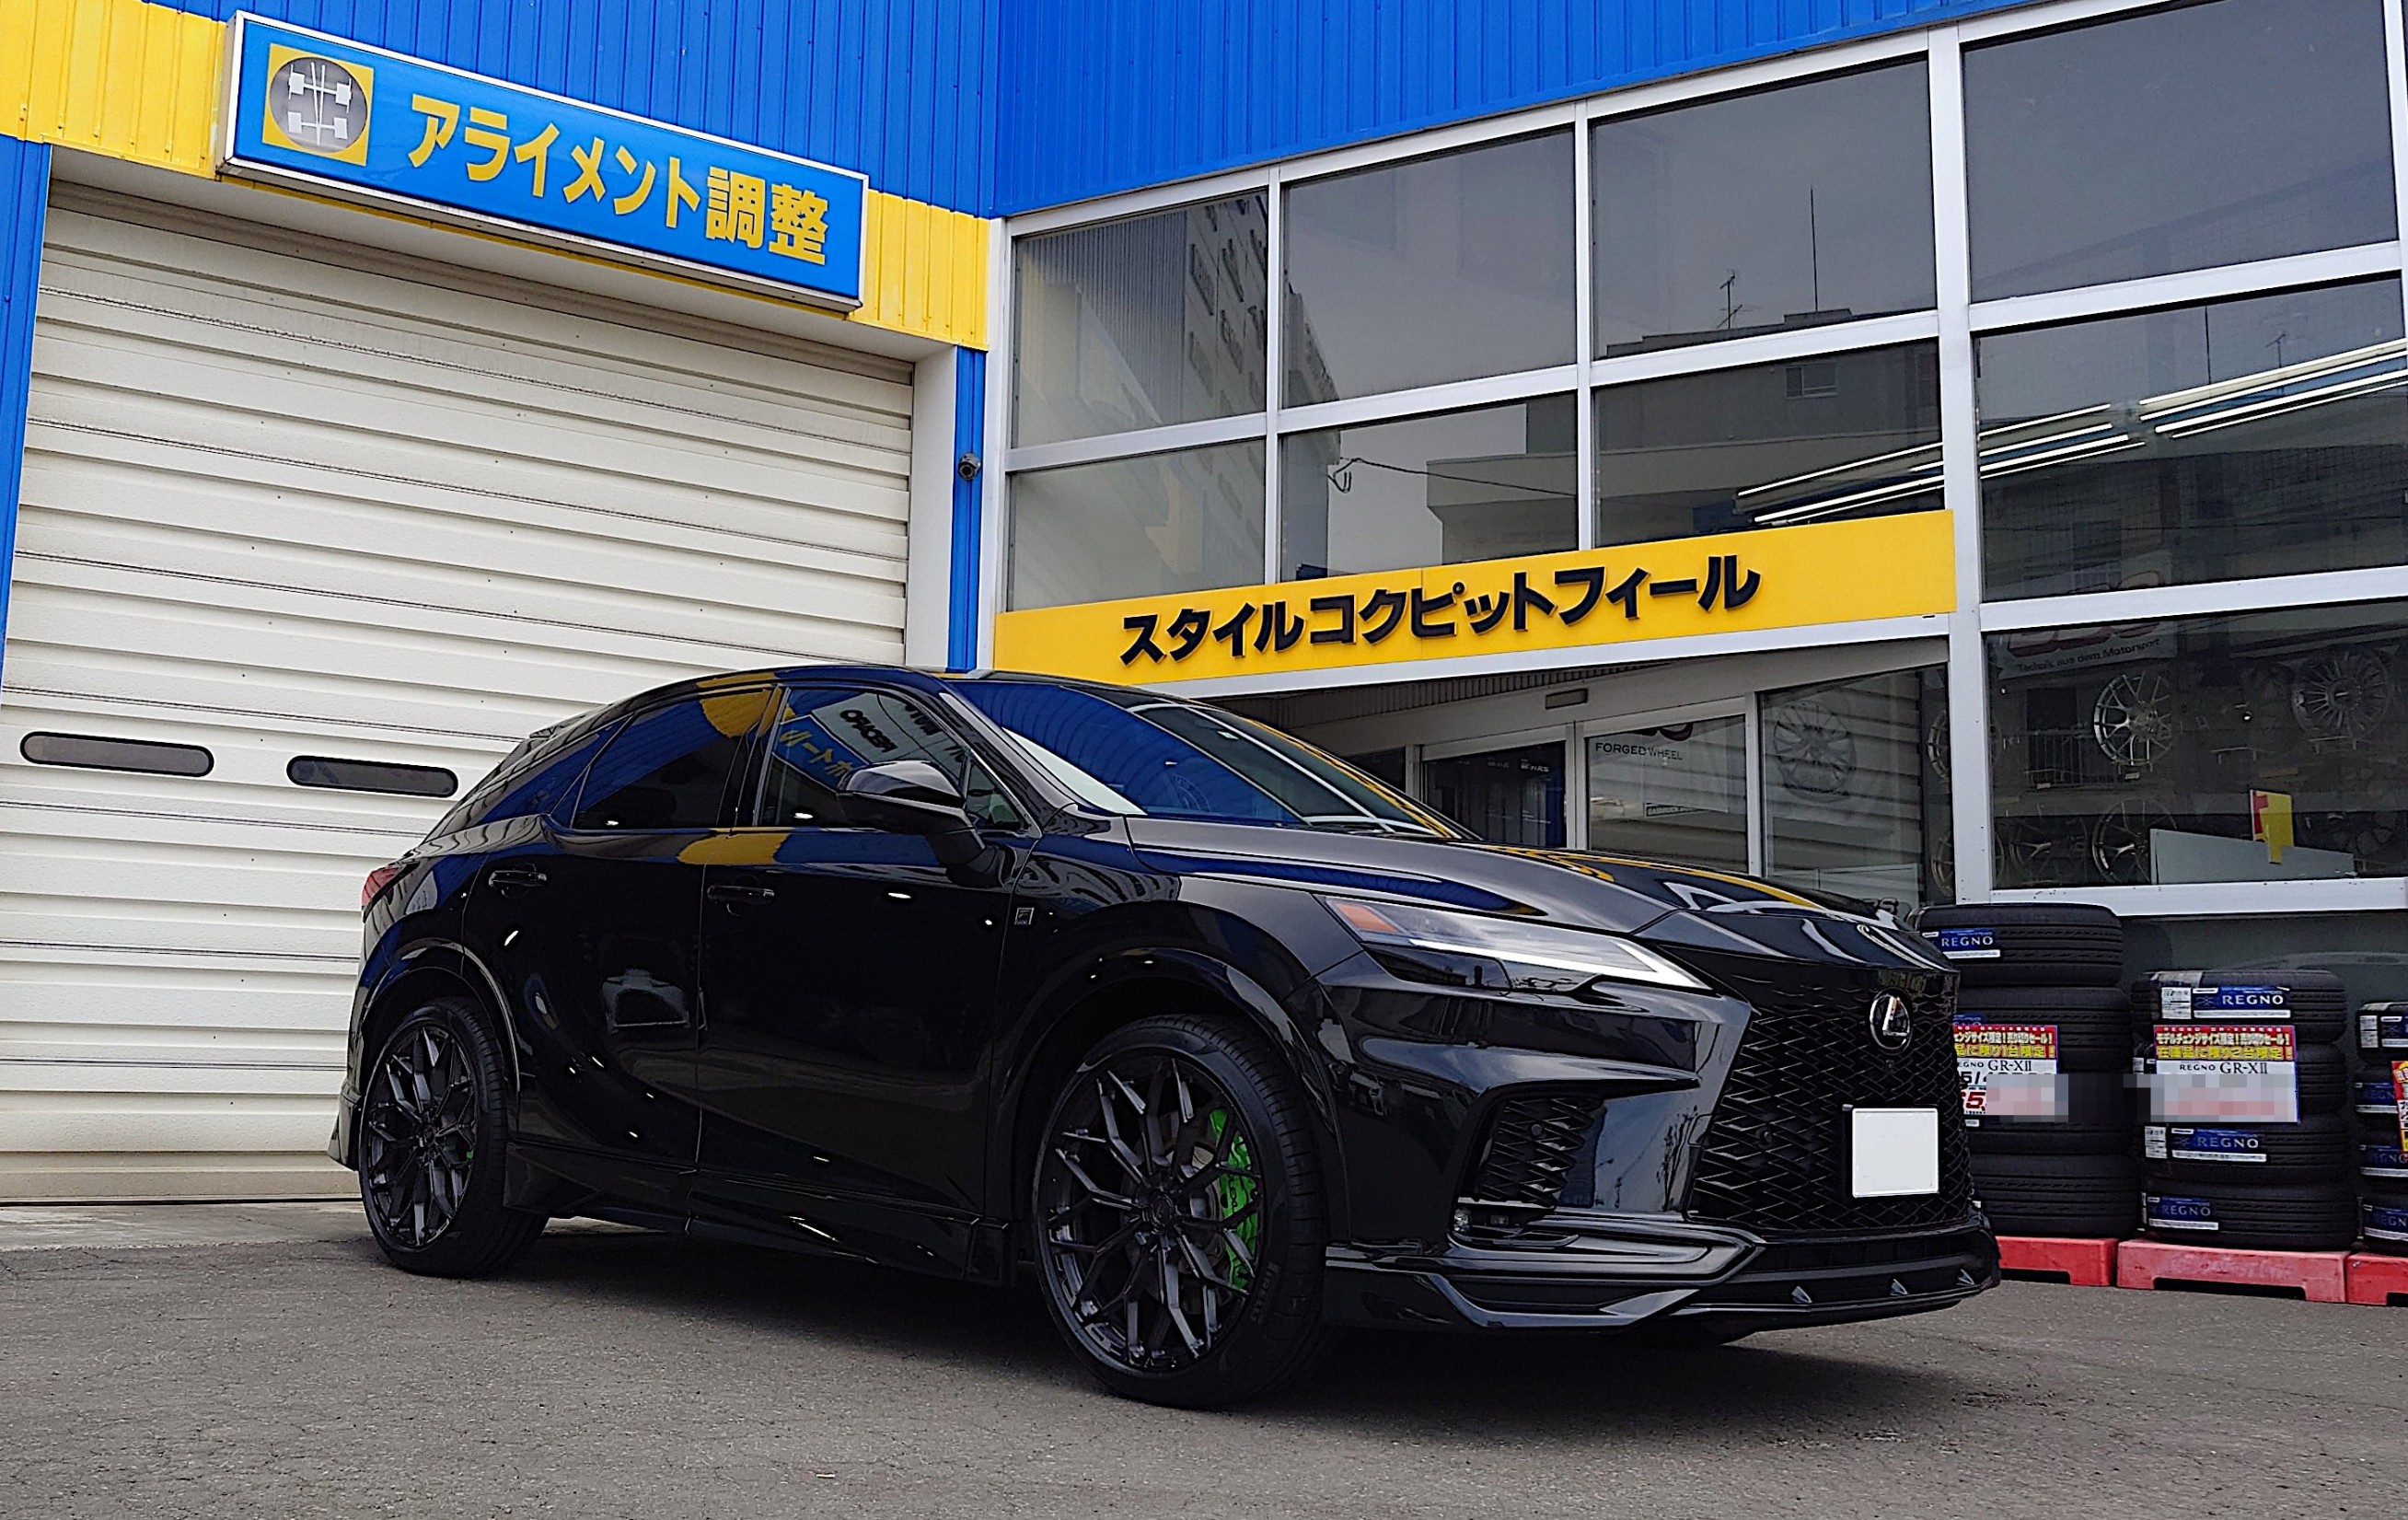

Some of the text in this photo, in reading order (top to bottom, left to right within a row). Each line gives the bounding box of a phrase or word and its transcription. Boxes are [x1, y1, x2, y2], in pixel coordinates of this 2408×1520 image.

[408, 93, 828, 265] アライメント調整
[1119, 554, 1760, 667] スタイルコクピットフィール
[1594, 742, 1684, 760] FORGED WHEEL
[1940, 935, 1994, 947] REGNO
[2221, 994, 2285, 1005] REGNO
[2179, 1063, 2217, 1072] REGNO
[2196, 1136, 2259, 1148] REGNO
[2161, 1204, 2212, 1217] REGNO
